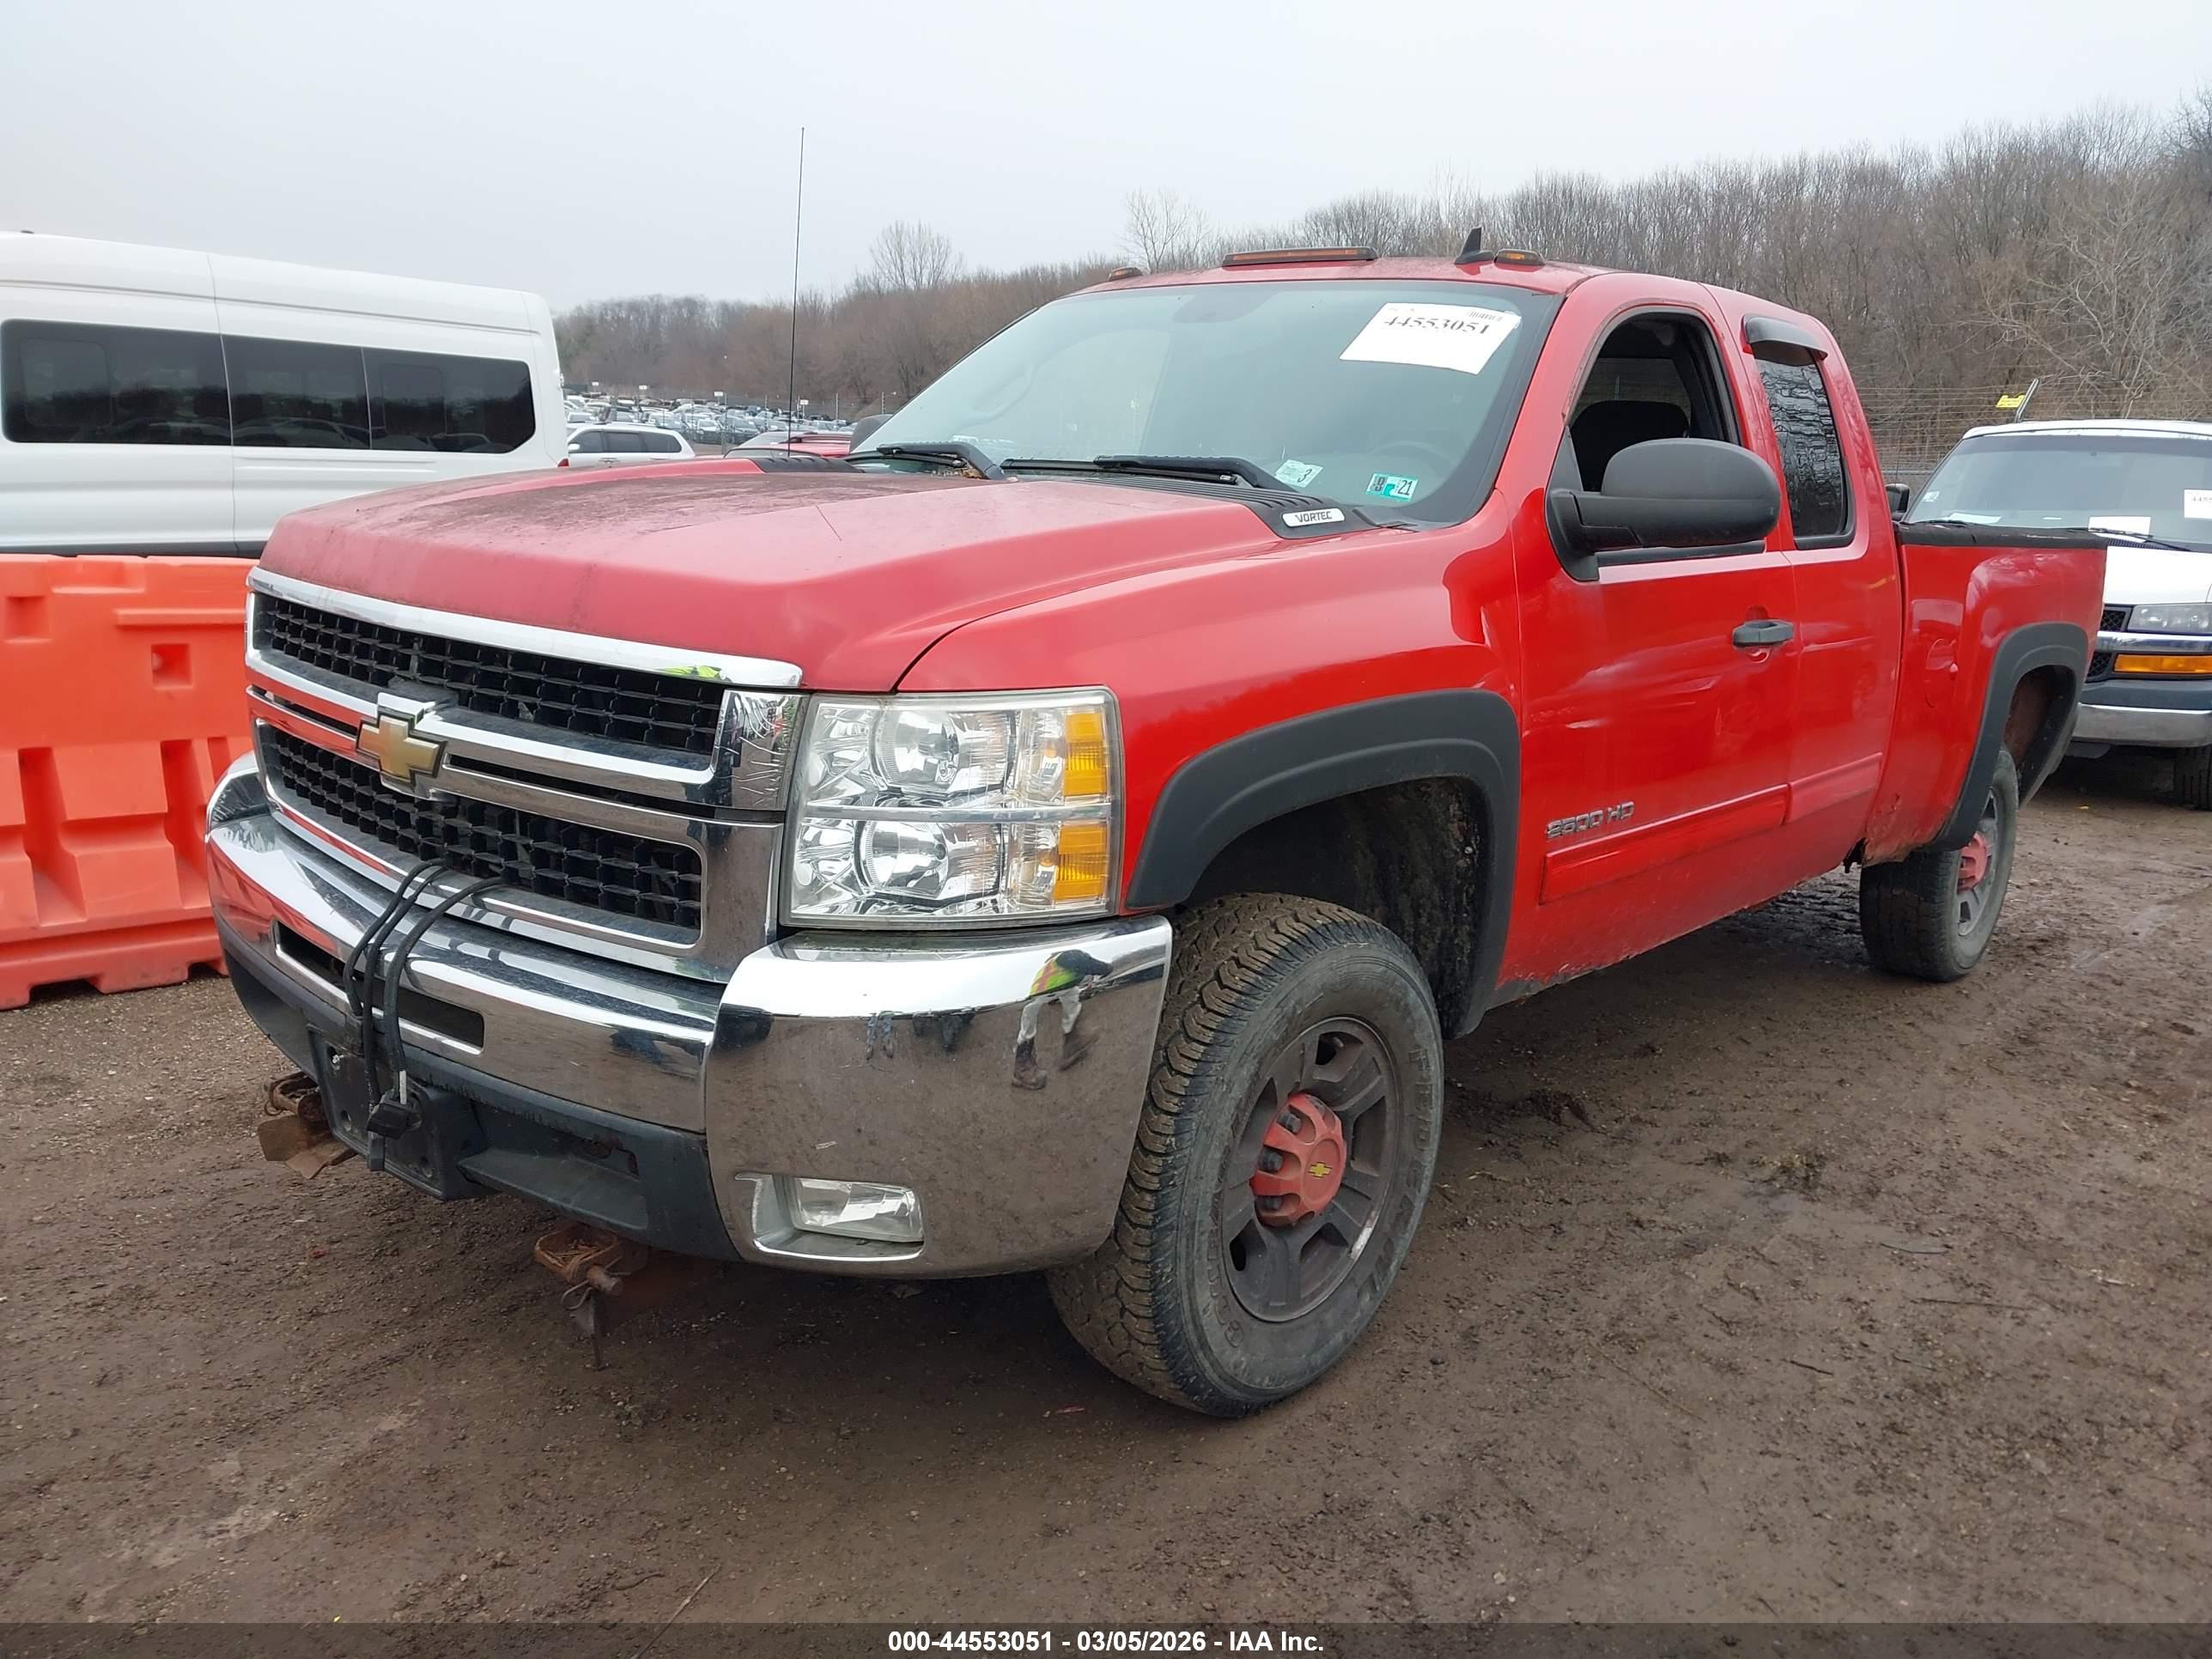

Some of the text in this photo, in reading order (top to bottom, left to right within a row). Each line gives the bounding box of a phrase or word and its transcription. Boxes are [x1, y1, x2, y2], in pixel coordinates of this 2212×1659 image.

[1383, 315, 1491, 334] 44553051
[1297, 468, 1313, 483] 3
[1397, 479, 1413, 495] 21
[1295, 510, 1333, 523] VORTEC
[1547, 801, 1635, 839] 2500 HD
